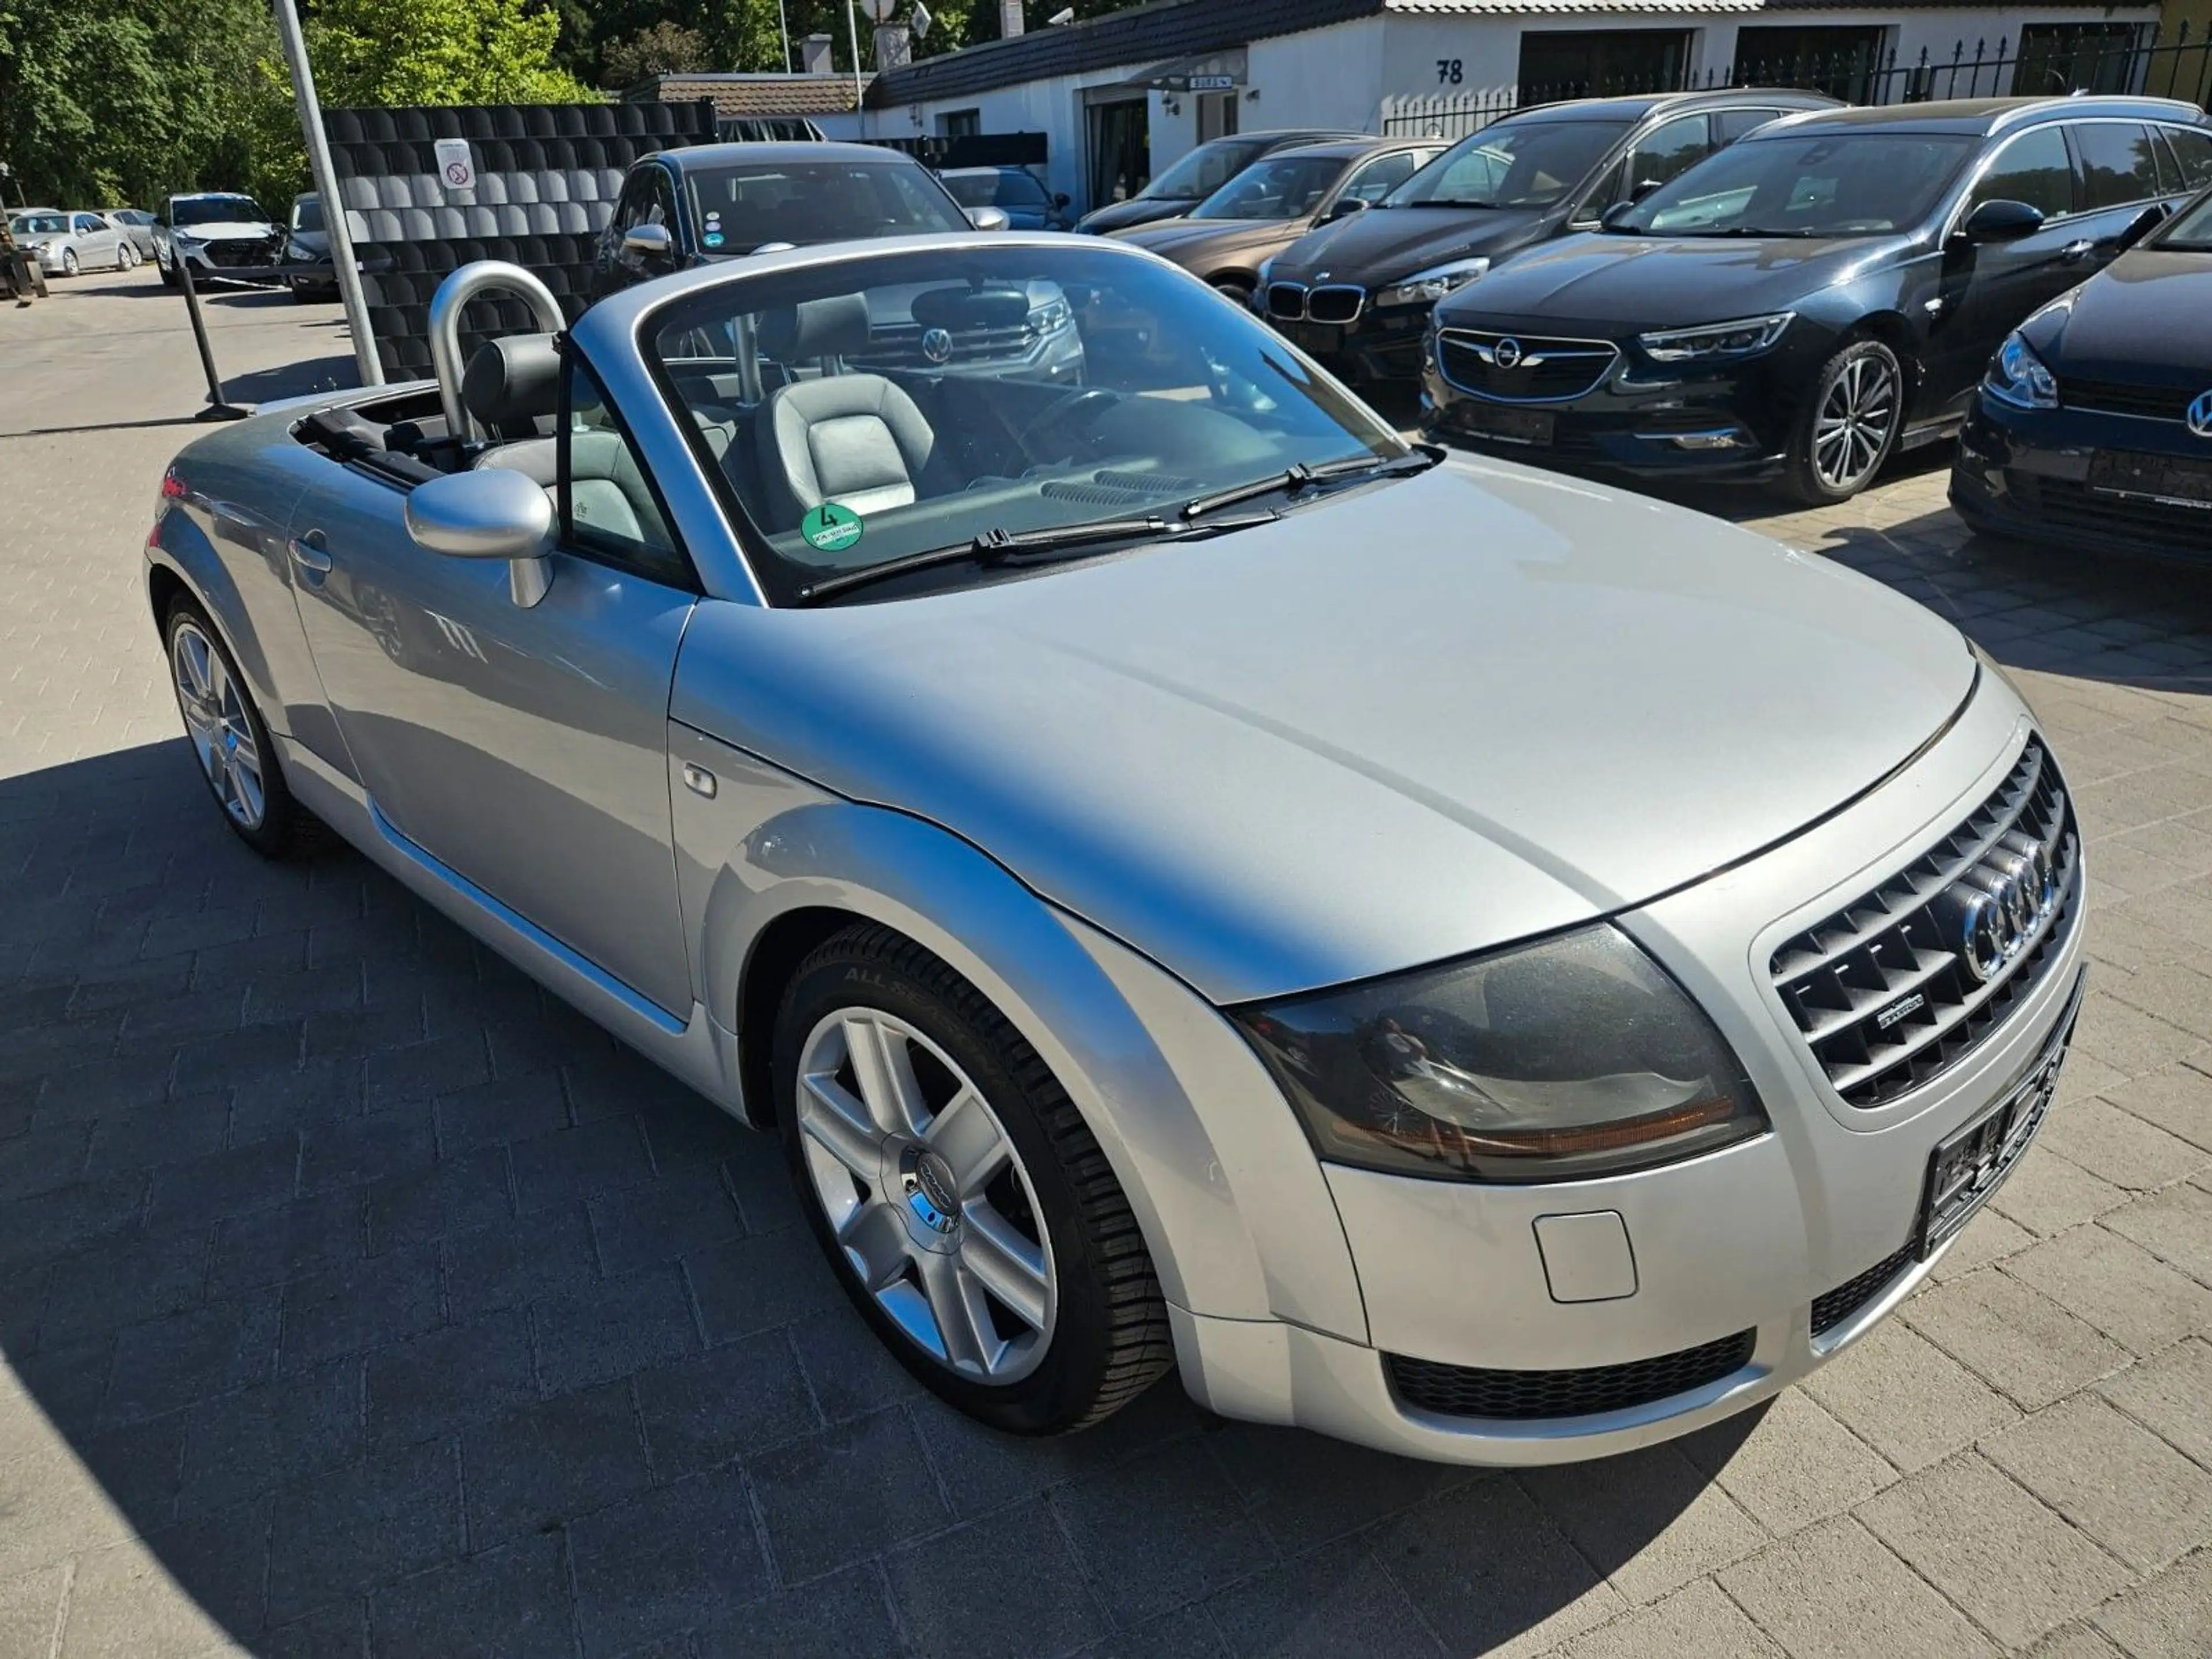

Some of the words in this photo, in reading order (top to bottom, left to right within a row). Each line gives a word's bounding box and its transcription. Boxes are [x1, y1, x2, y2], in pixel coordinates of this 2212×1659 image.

[1436, 59, 1463, 85] 78
[821, 507, 838, 526] 4
[844, 967, 886, 988] ALL
